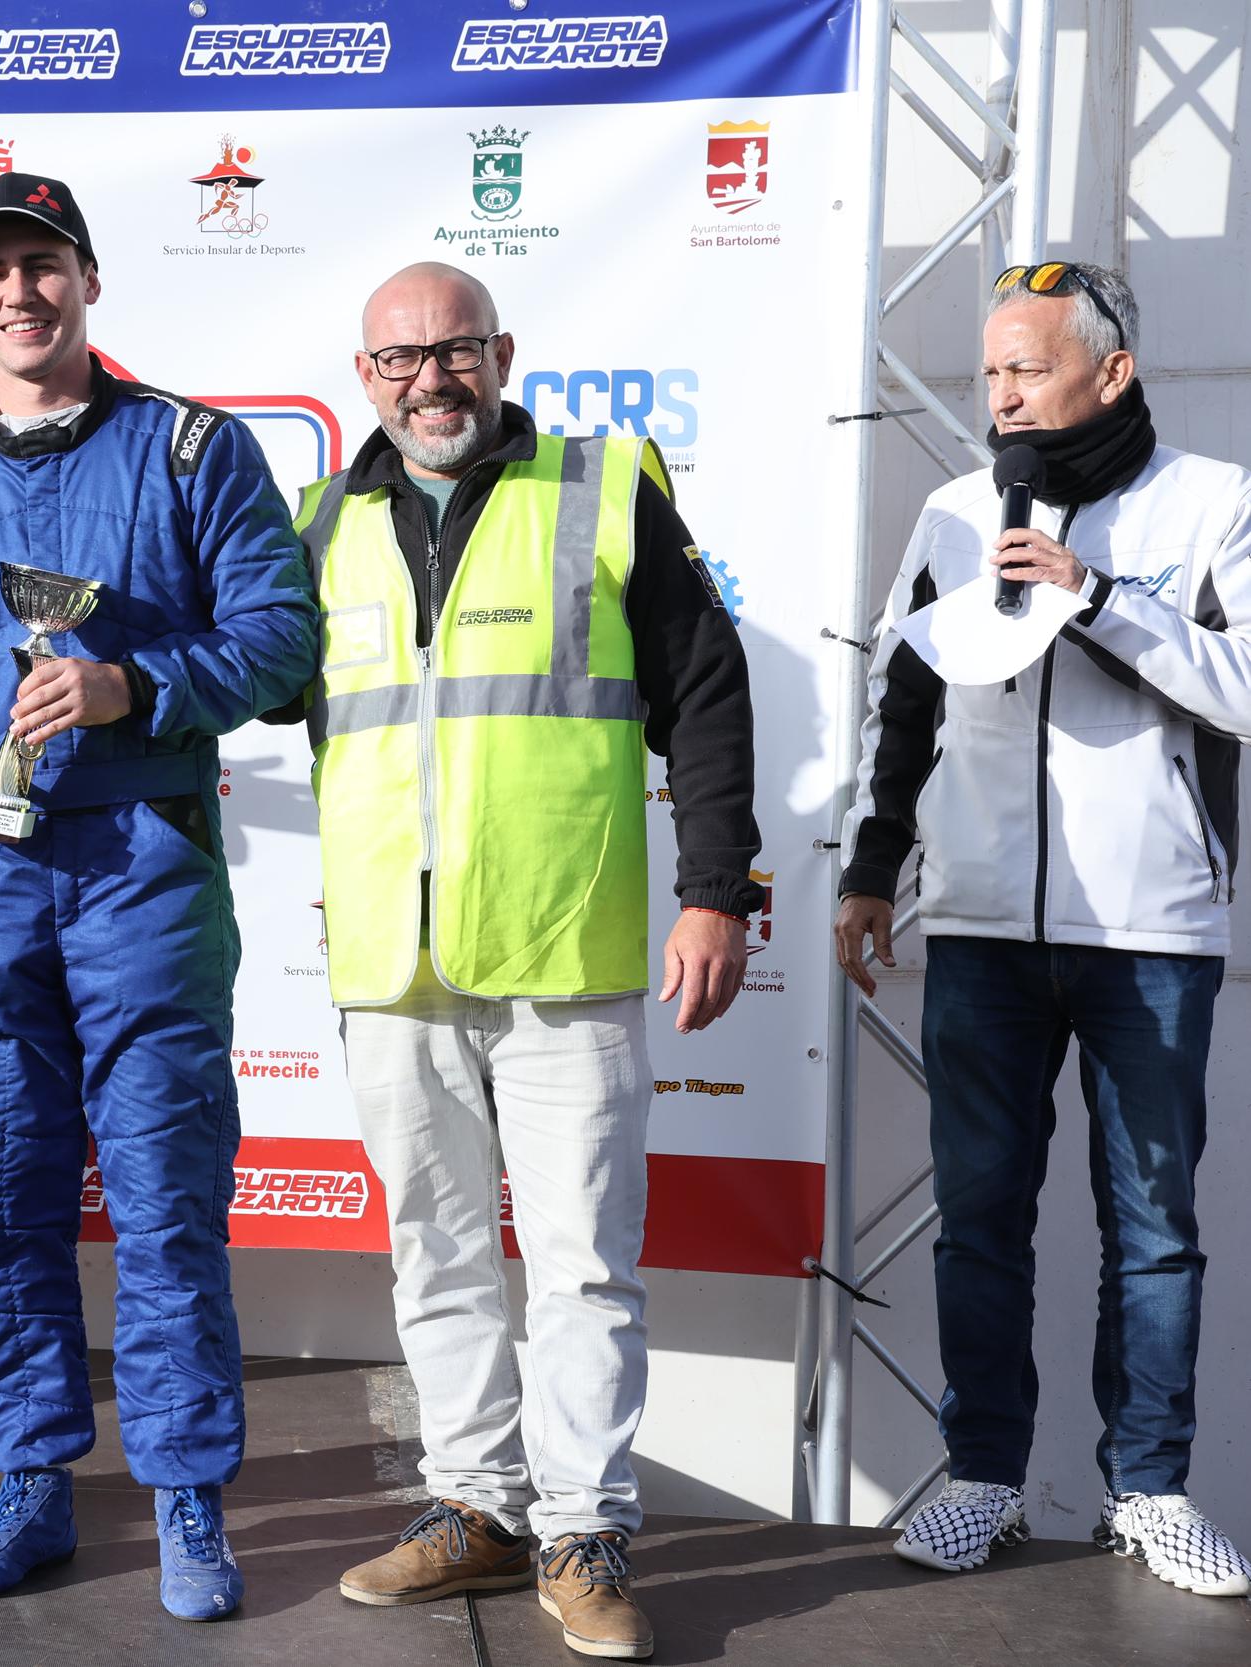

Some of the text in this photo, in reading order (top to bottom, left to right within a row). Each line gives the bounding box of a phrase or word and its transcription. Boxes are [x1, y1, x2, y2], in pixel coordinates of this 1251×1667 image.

[463, 20, 663, 44] ESCUDERIA
[190, 29, 387, 51] ESCUDERIA
[185, 48, 384, 71] LANZAROTE
[457, 41, 661, 65] LANZAROTE
[433, 224, 559, 244] Ayuntamiento
[690, 222, 781, 235] Ayuntamiento de
[690, 234, 781, 247] San Bartolomé
[163, 244, 306, 256] Servicio Insular de Deportes
[465, 241, 527, 256] de Tías
[523, 368, 699, 448] CCRS
[180, 412, 215, 461] sparco
[663, 453, 695, 462] NARIAS
[668, 463, 695, 473] PRINT
[459, 608, 533, 619] ESCUDERIA
[457, 615, 533, 626] LANZAROTE
[283, 965, 326, 977] Servicio
[770, 969, 786, 979] de
[741, 980, 785, 992] tolomé
[250, 1050, 264, 1058] DE
[268, 1050, 320, 1060] SERVICIO
[237, 1060, 320, 1079] Arrecife
[653, 1079, 745, 1096] upo Tiagua
